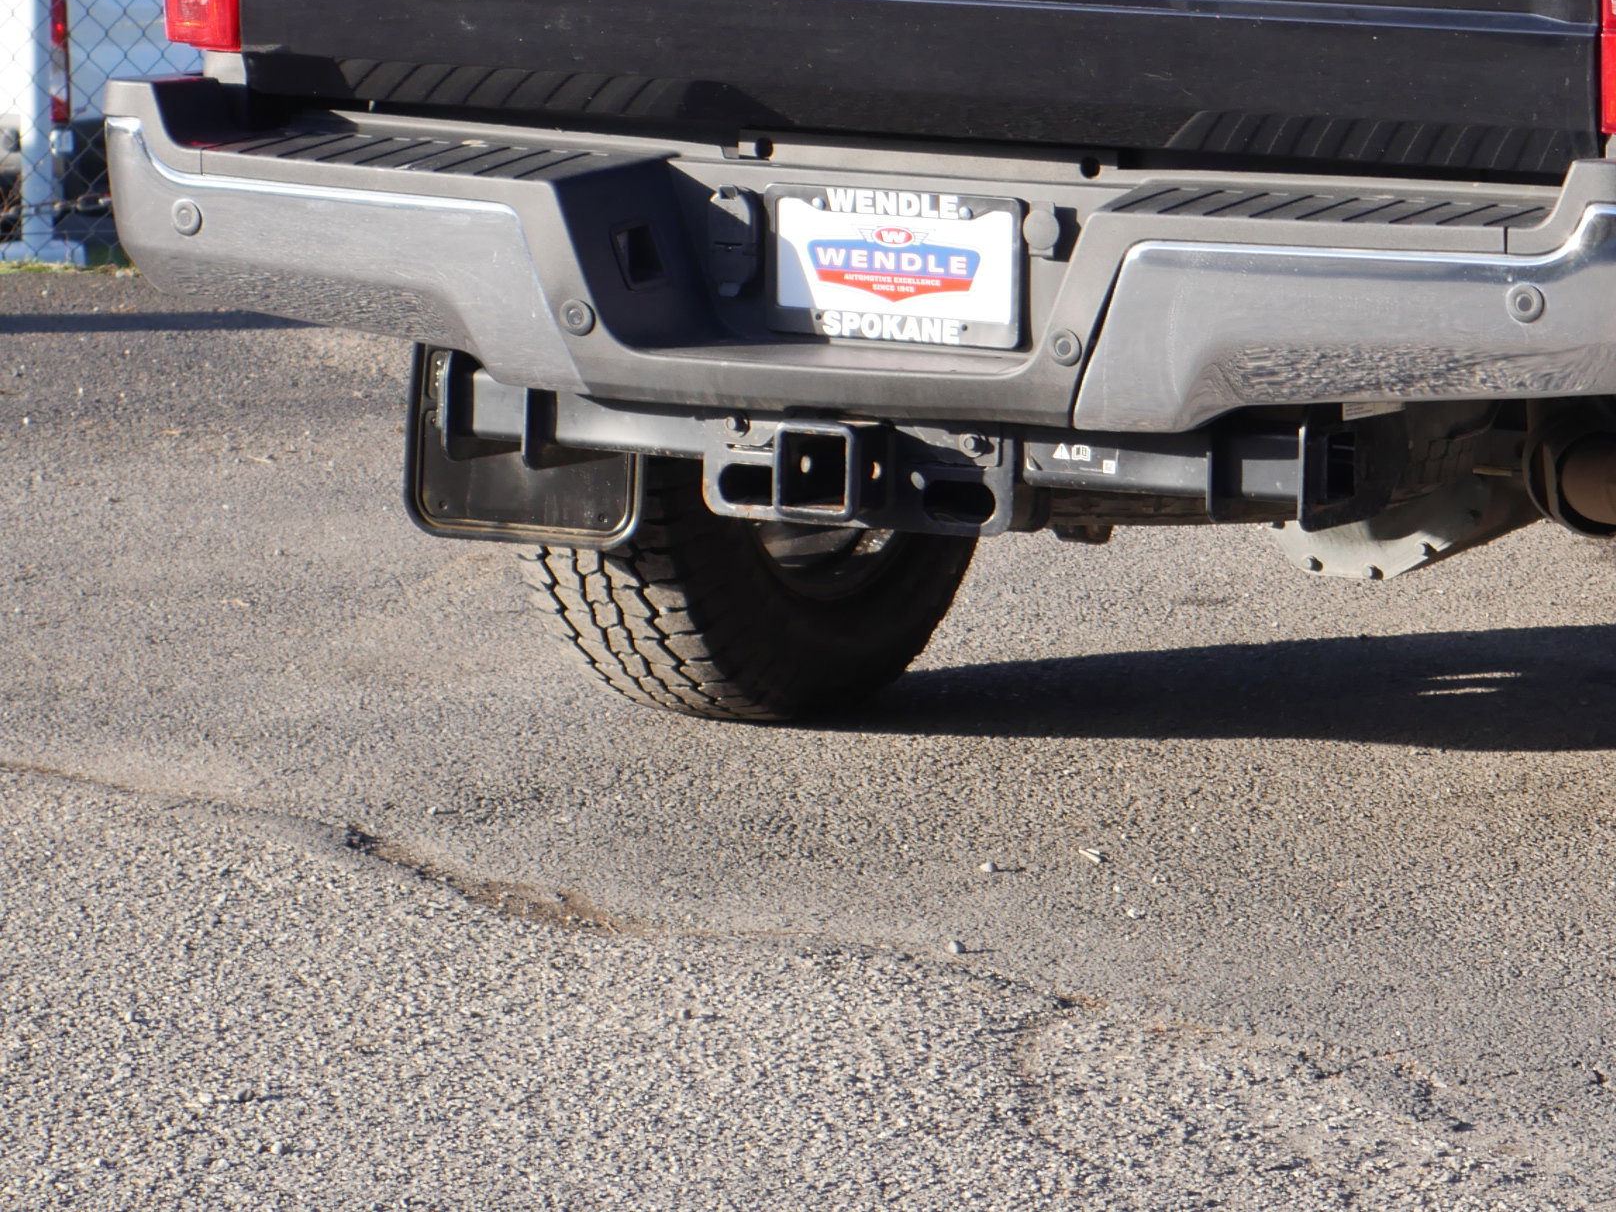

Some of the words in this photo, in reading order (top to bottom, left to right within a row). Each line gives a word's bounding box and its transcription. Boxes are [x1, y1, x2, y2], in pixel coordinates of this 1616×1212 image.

[826, 188, 960, 219] WENDLE
[816, 247, 968, 275] WENDLE
[822, 310, 960, 345] SPOKANE
